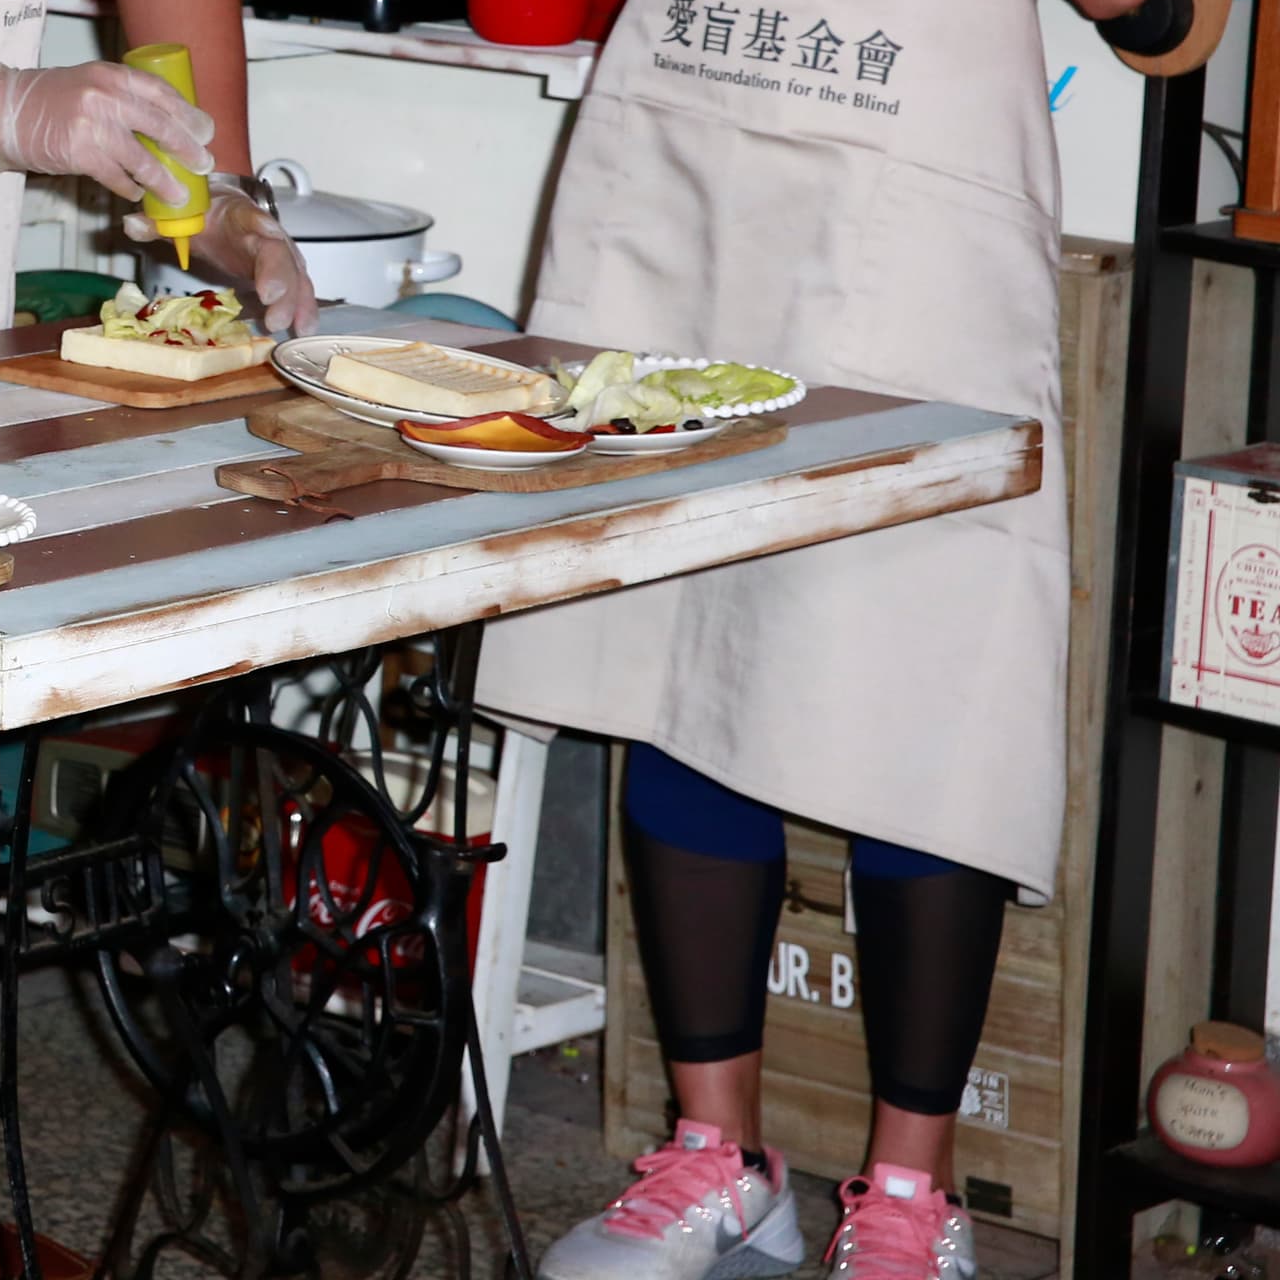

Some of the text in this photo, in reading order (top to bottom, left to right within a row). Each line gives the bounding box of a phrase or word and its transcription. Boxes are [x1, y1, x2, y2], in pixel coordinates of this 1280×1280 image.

[653, 53, 900, 116] Taiwan Foundation for the Blind
